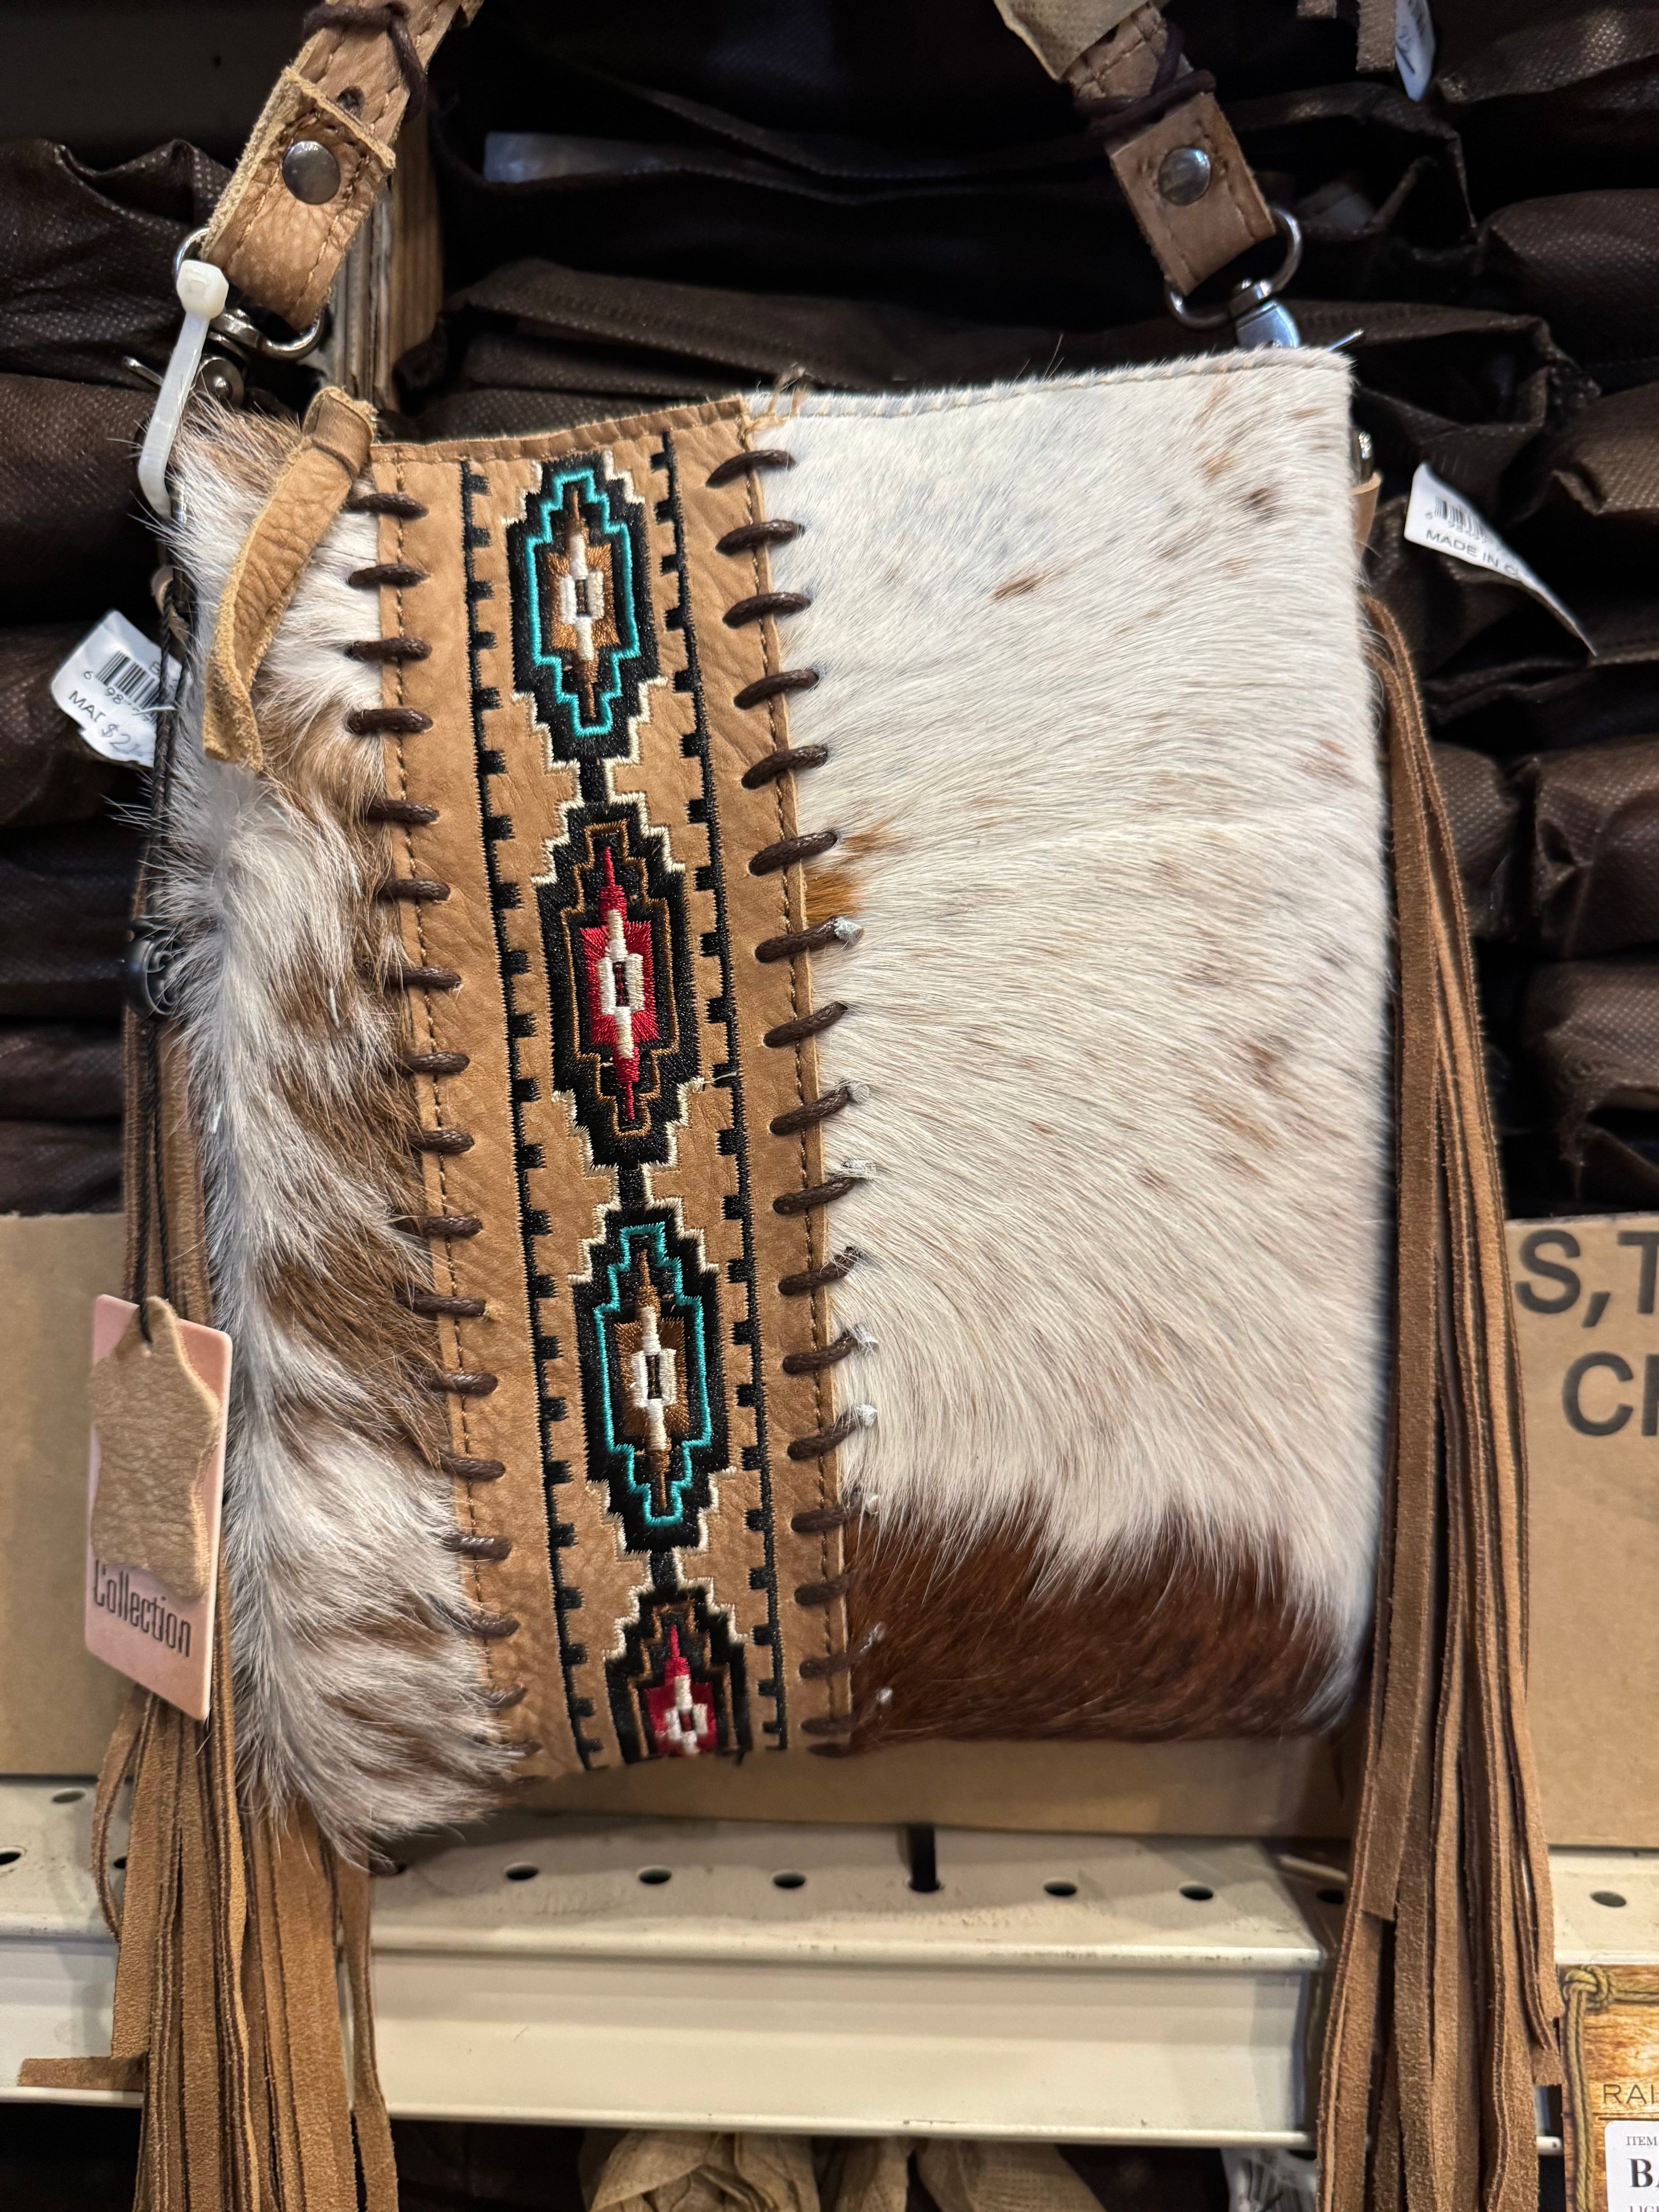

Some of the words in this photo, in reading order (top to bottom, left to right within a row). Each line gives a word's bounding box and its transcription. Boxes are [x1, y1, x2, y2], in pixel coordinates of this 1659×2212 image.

[1426, 529, 1477, 558] MADE
[1483, 552, 1499, 567] IN
[94, 1559, 191, 1658] Collection
[1626, 2136, 1658, 2146] ITEM
[1627, 2158, 1659, 2188] B
